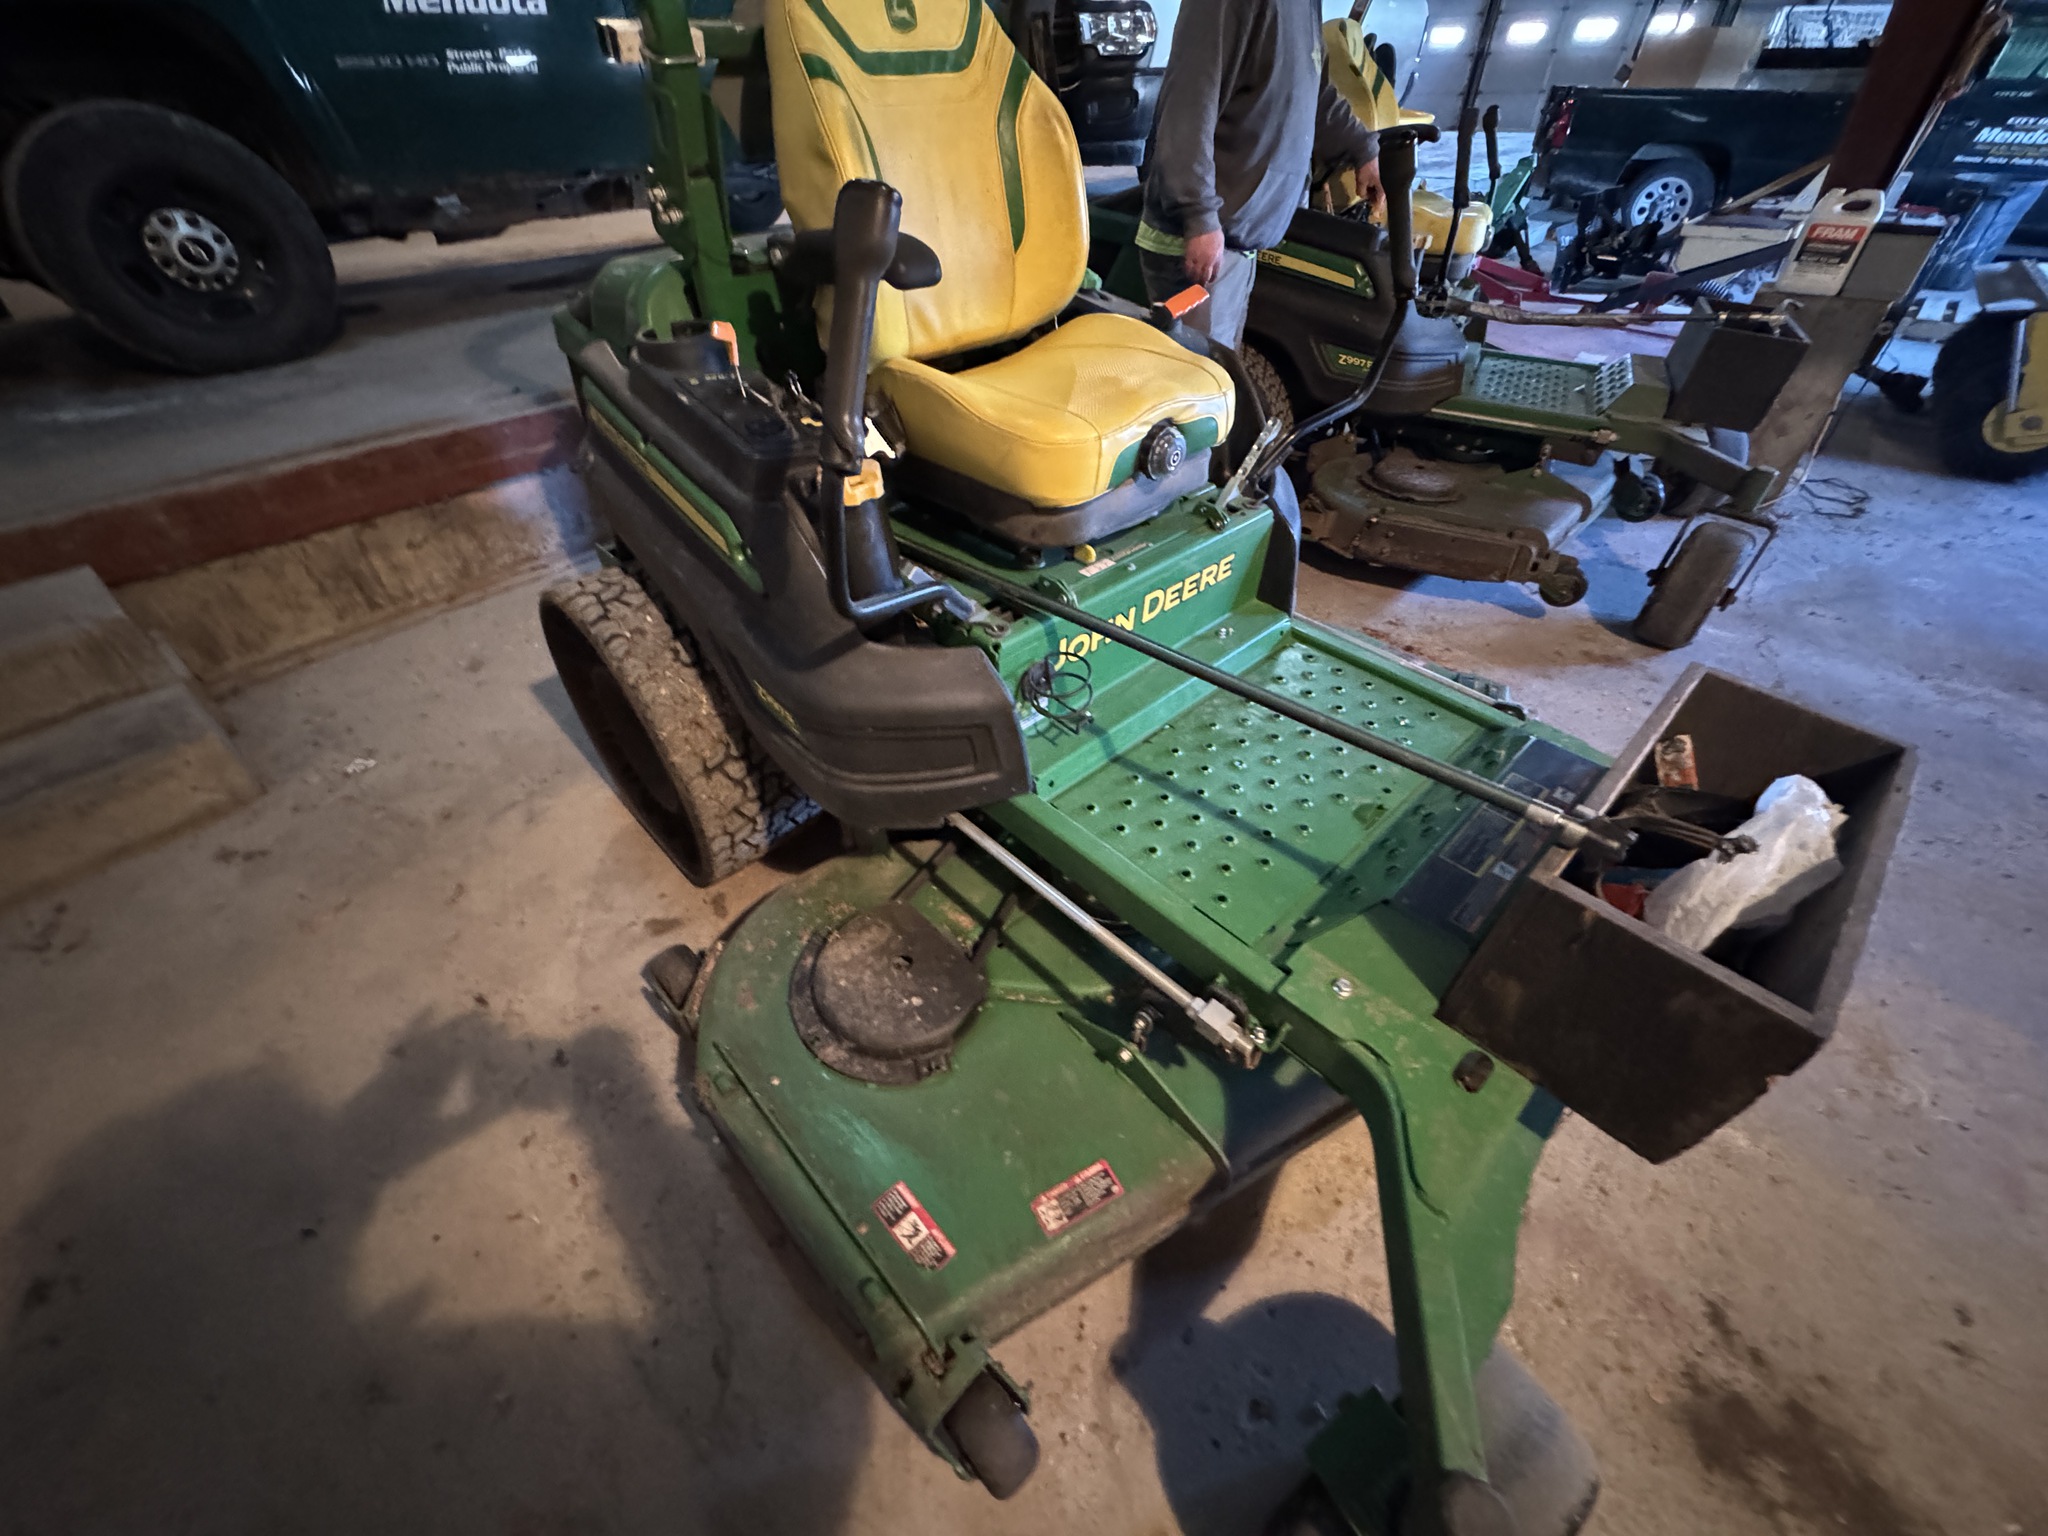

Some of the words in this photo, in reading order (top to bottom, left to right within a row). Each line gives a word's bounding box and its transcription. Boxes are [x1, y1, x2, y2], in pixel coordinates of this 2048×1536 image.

[447, 61, 484, 75] Public
[1811, 225, 1858, 240] FRAM
[1258, 250, 1281, 265] ERE
[1141, 553, 1236, 624] DEERE
